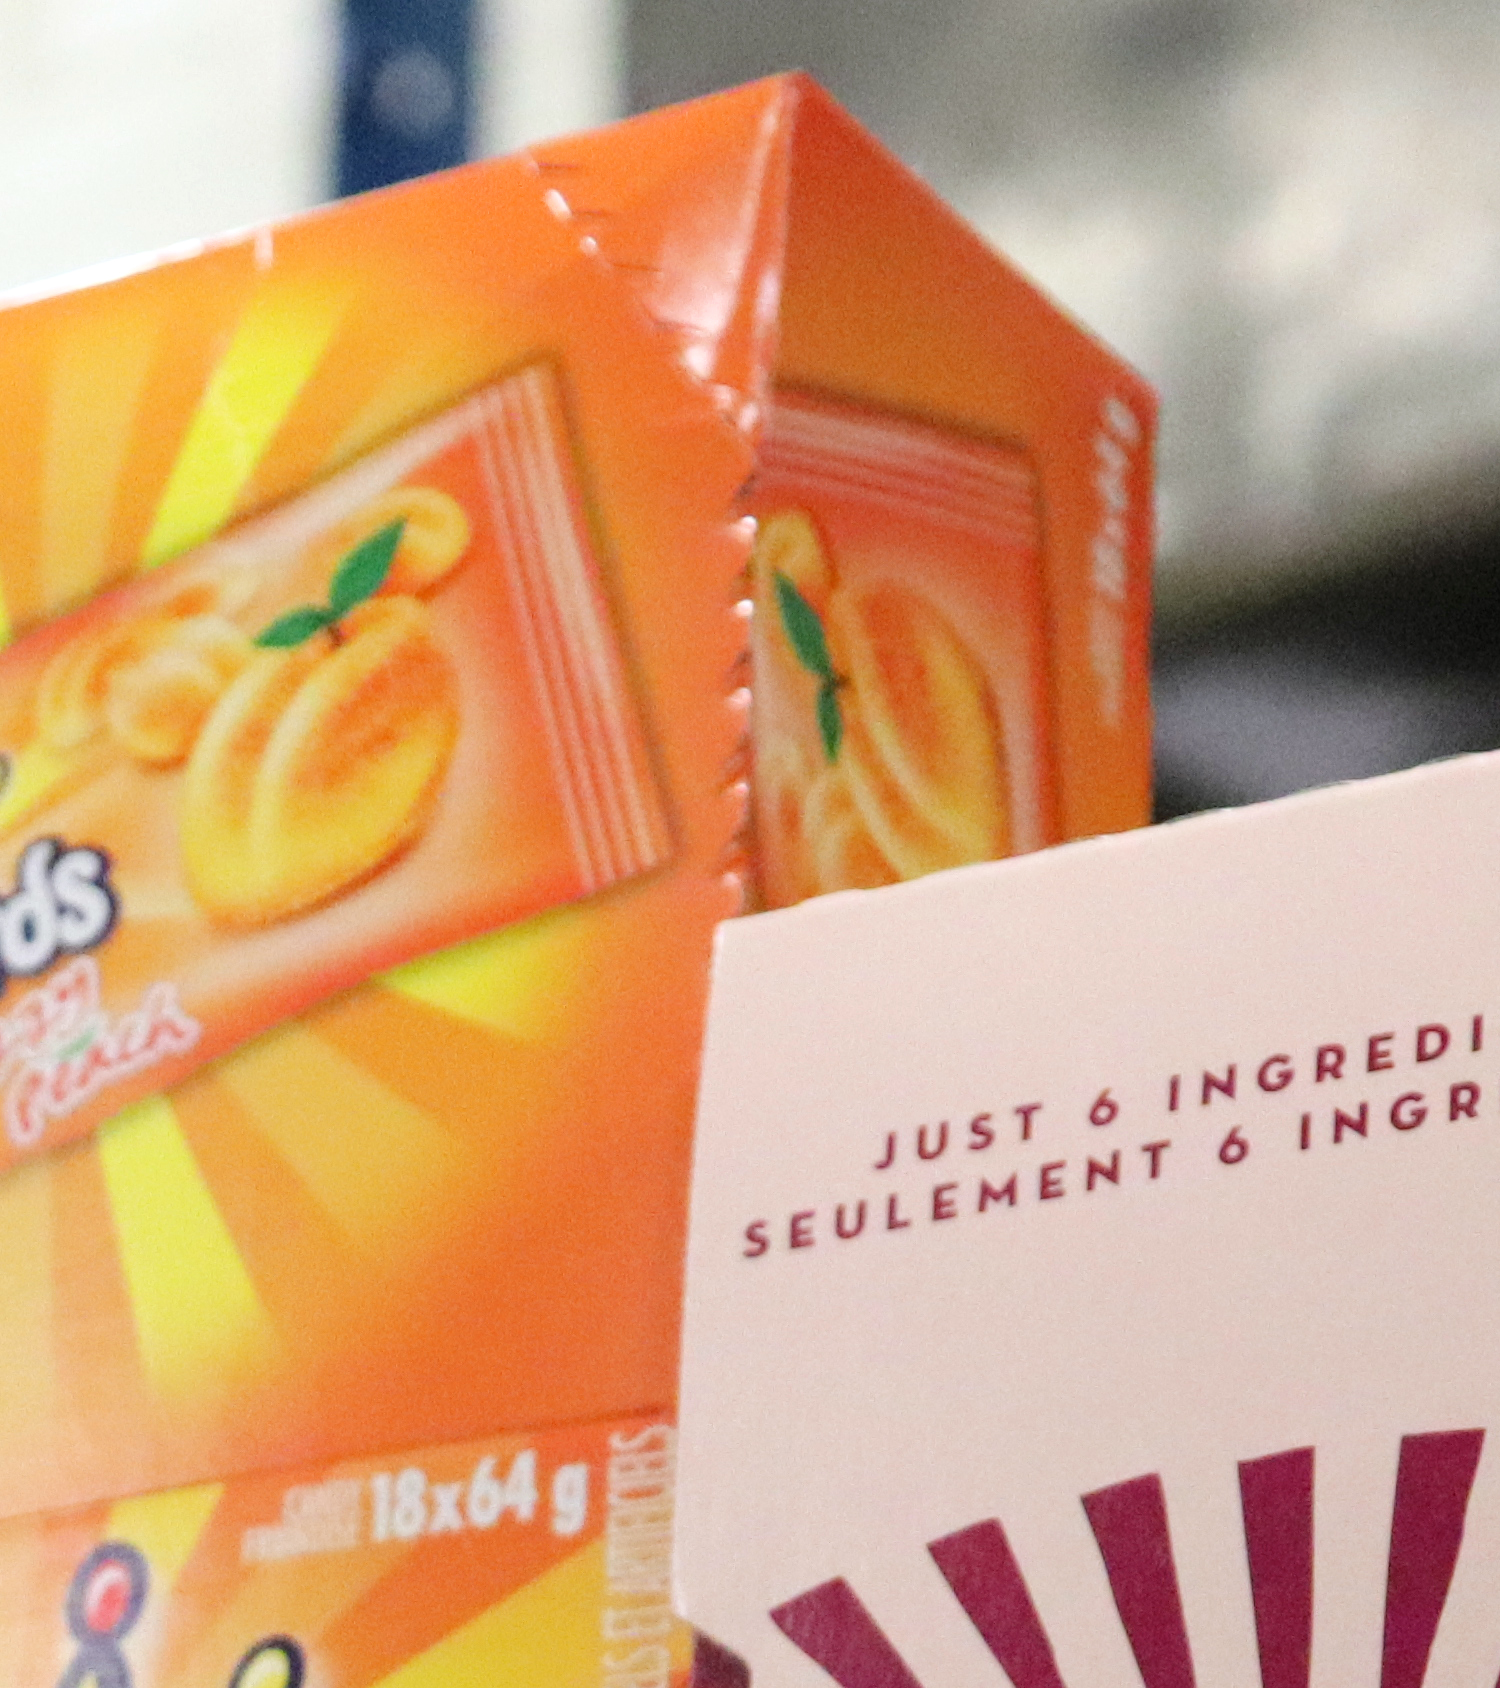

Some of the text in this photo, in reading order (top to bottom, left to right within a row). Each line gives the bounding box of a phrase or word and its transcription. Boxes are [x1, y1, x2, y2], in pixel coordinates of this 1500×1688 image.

[872, 1099, 1046, 1172] JUST
[1087, 1086, 1121, 1130] 6
[742, 1139, 1175, 1262] SEULEMENT
[1216, 1123, 1252, 1169] 6
